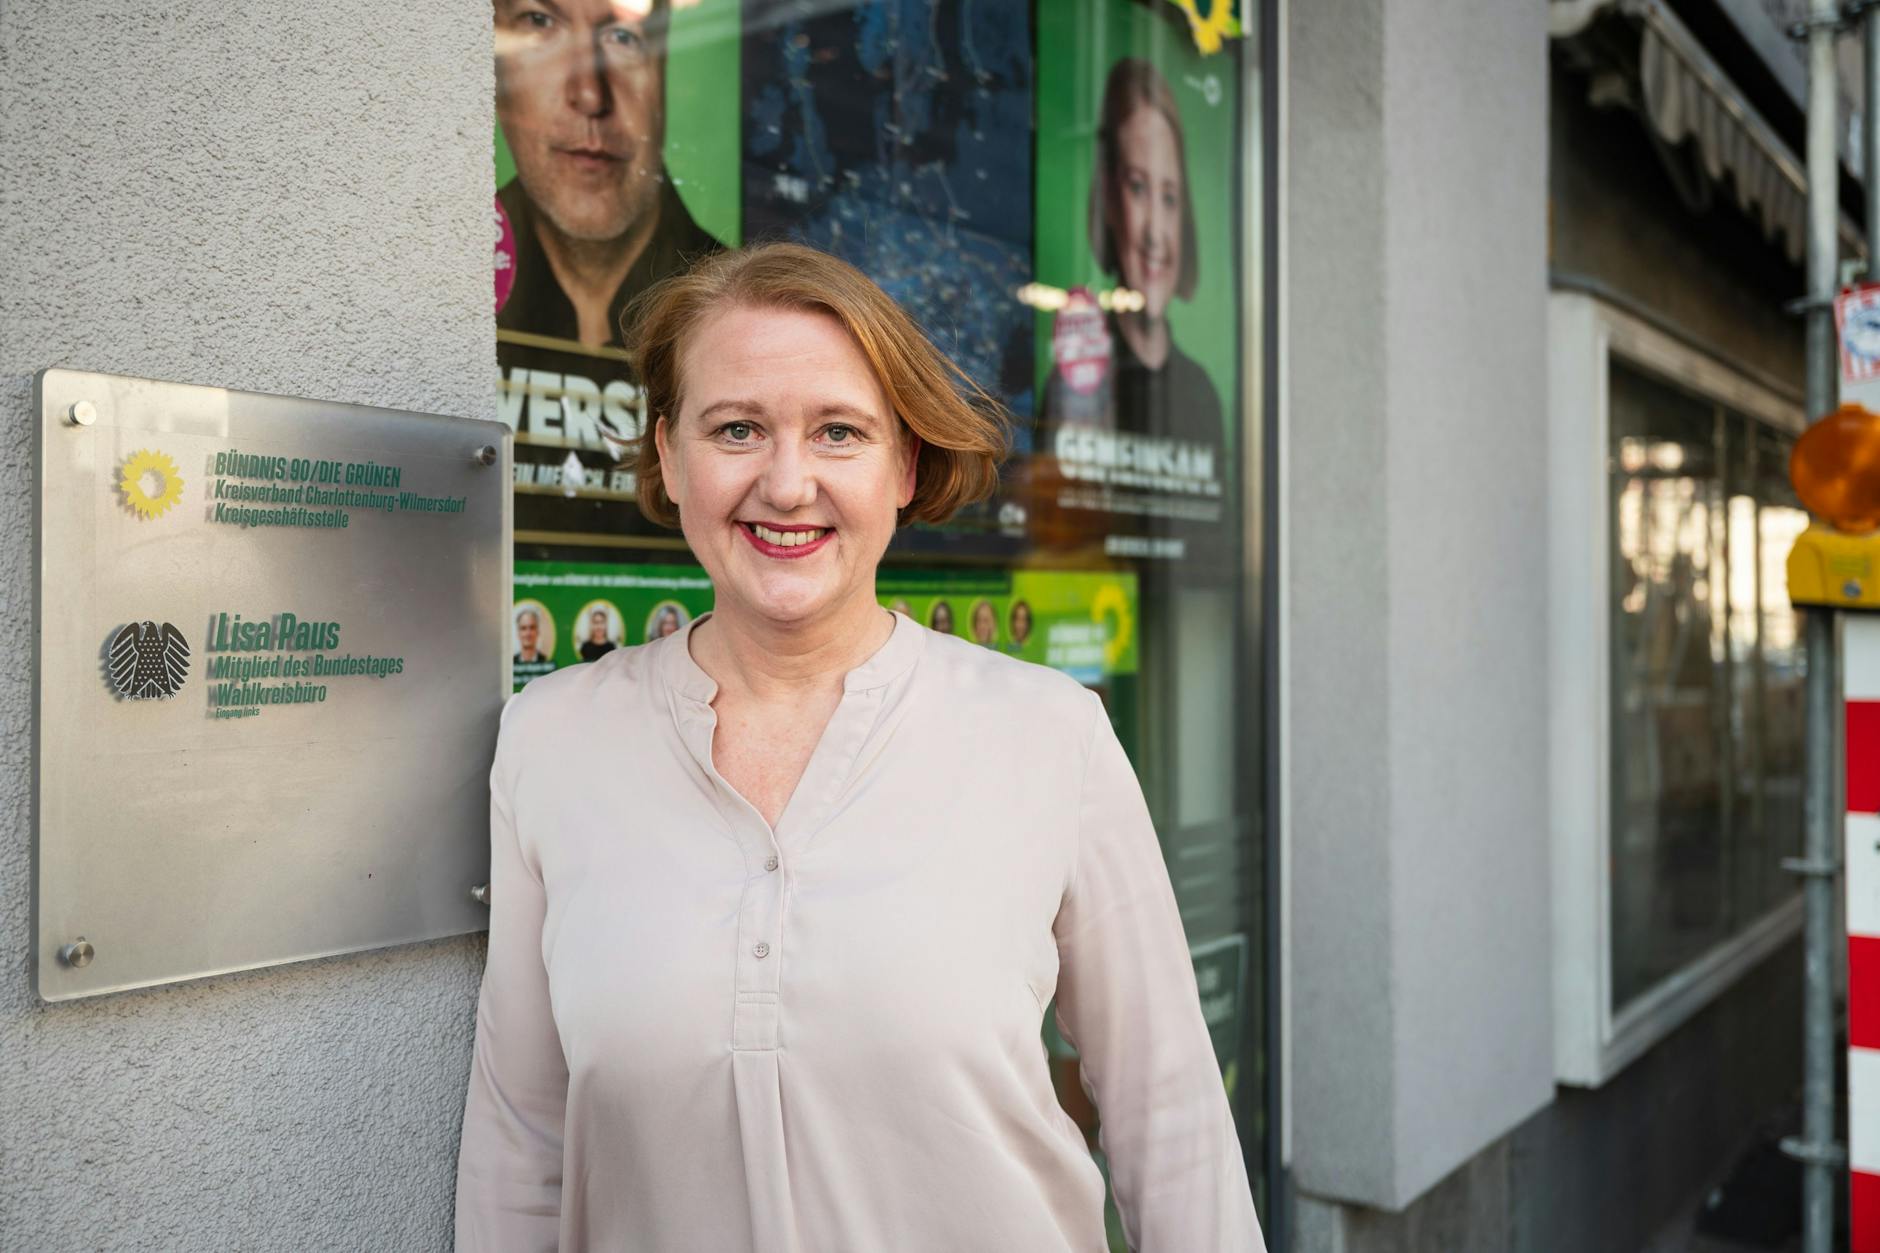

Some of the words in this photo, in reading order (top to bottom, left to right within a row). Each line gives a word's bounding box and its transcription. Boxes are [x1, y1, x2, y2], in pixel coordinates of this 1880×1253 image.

[215, 449, 287, 480] BÜNDNIS
[290, 458, 343, 484] 90/DIE
[345, 461, 401, 488] GRÜNEN
[215, 479, 303, 504] Kreisverband
[305, 484, 467, 512] Charlottenburg-Wilmersdorf
[215, 502, 349, 528] Kreisgeschäftsstelle
[216, 612, 271, 652] Lisa
[278, 612, 341, 650] Paus
[216, 655, 281, 682] Mitglied
[283, 655, 310, 677] des
[313, 653, 404, 678] Bundestages
[217, 681, 327, 706] Wahlkreisbüro
